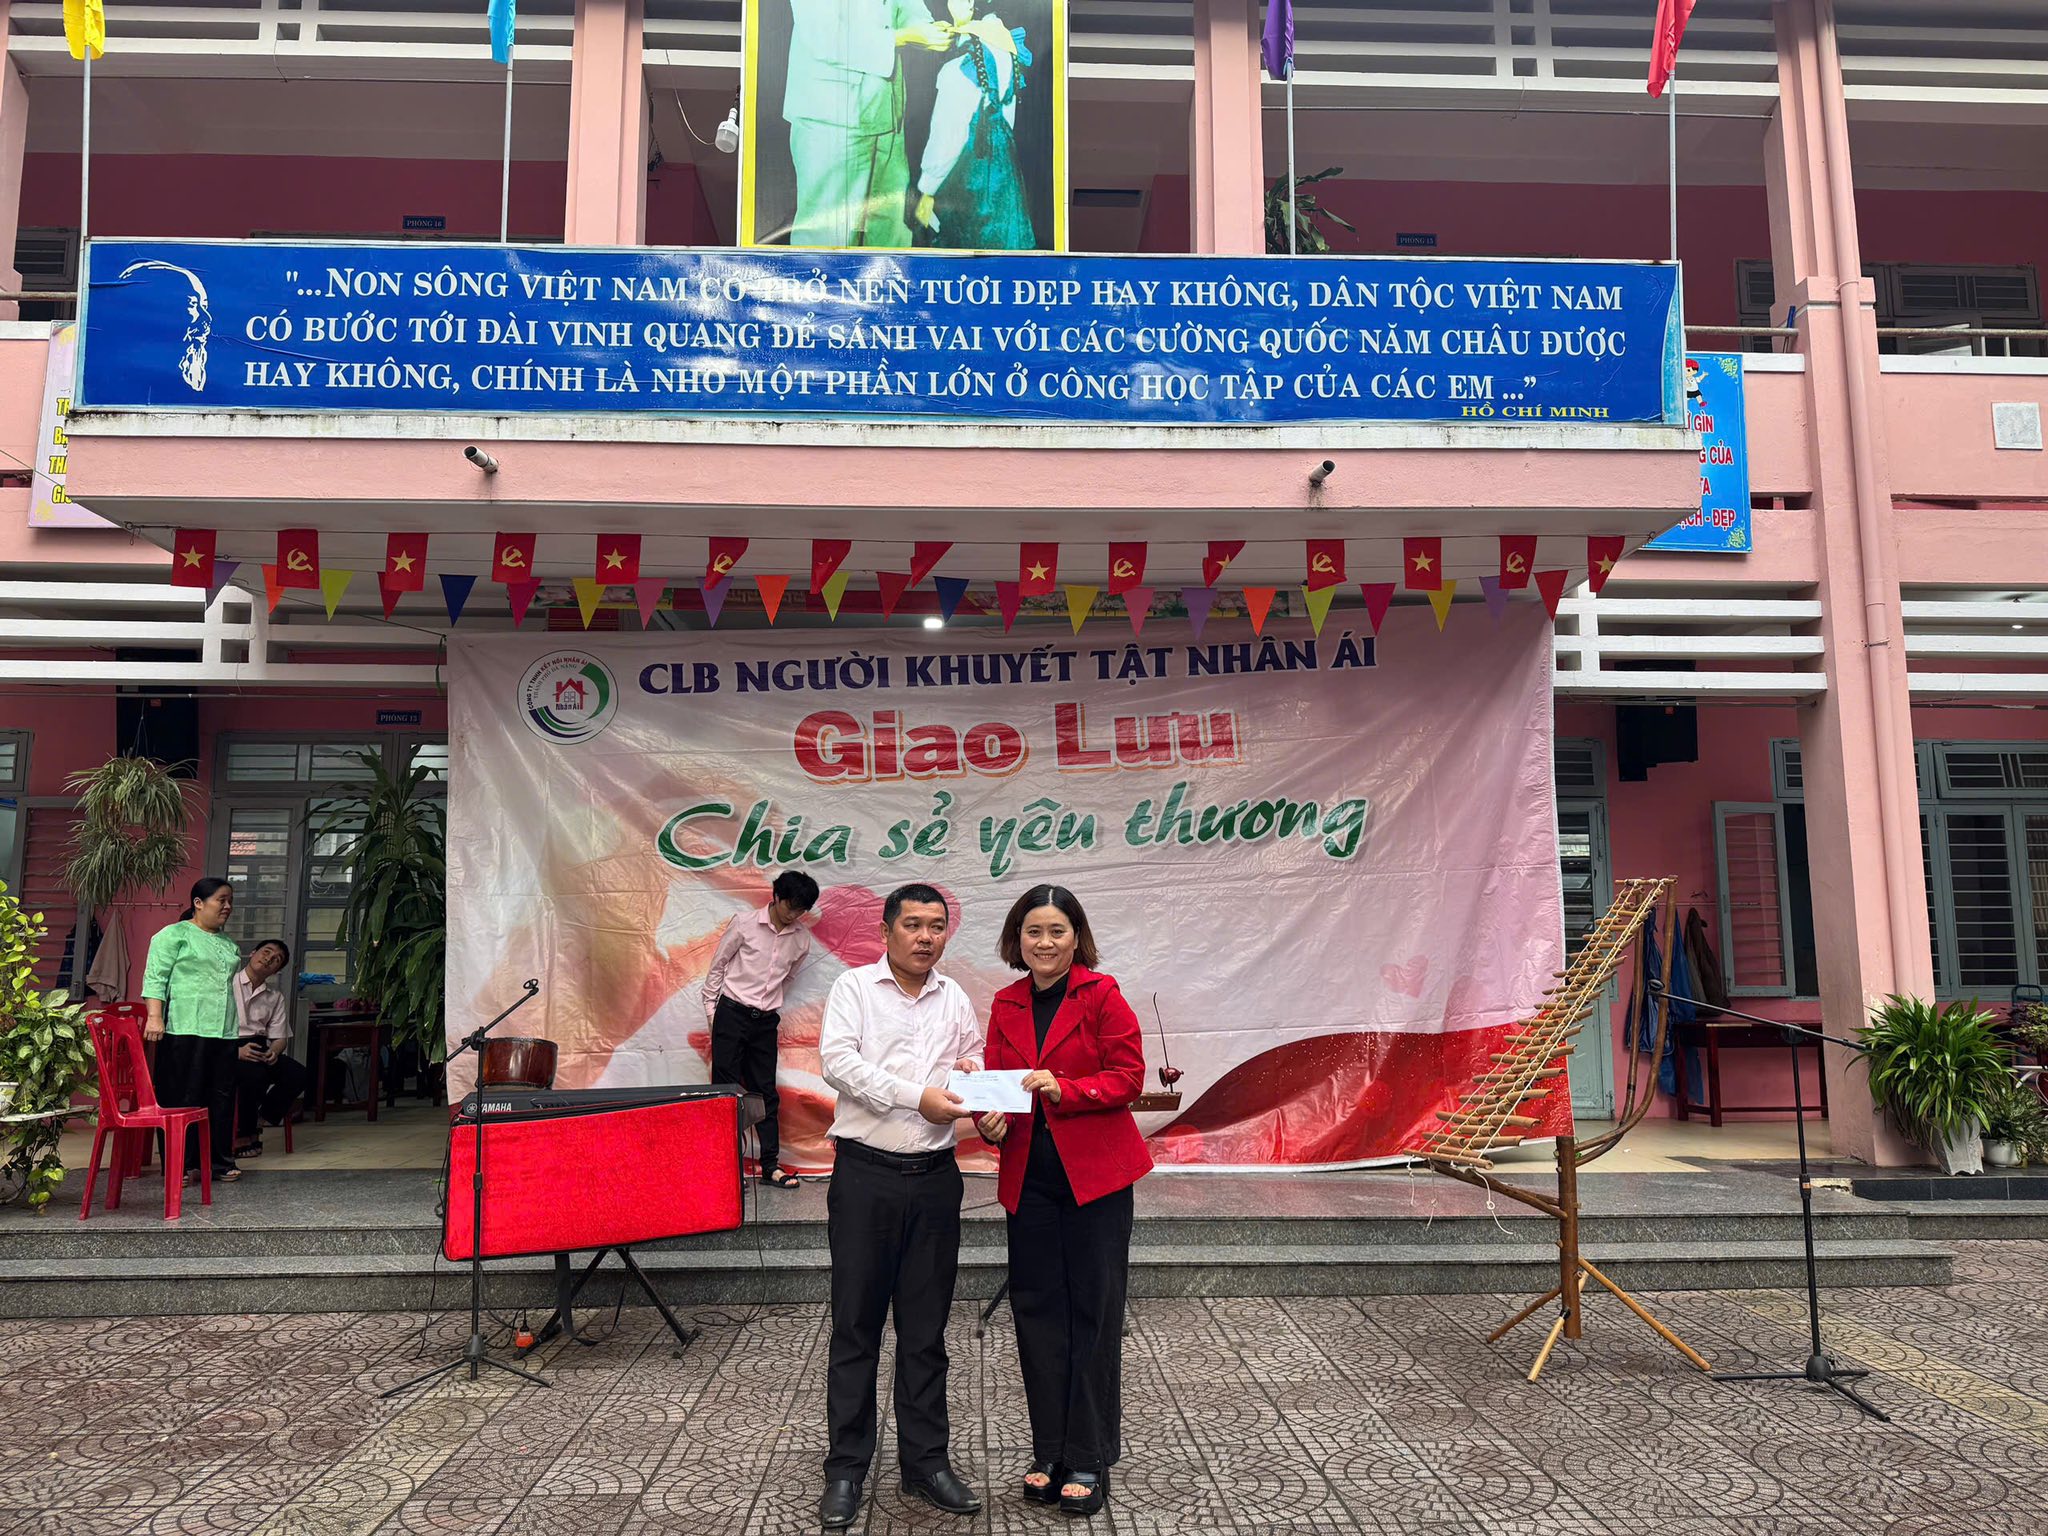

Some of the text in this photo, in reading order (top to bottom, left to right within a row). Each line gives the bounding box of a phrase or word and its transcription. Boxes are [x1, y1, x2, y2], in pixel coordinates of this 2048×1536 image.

[414, 265, 509, 298] SÔNG
[518, 269, 601, 307] VIỆT
[611, 277, 689, 301] NAM
[921, 274, 1002, 305] TƯƠI
[1013, 280, 1082, 311] ĐẸP
[1091, 281, 1160, 306] HAY
[1170, 274, 1299, 312] KHÔNG,
[1309, 275, 1379, 307] DÂN
[1389, 276, 1454, 315] TỘC
[1464, 277, 1542, 315] VIỆT
[1551, 286, 1623, 310] NAM
[245, 309, 1626, 362] CÓ BƯỚC TỚI ĐÀI VINH QUANG ĐỂ SÁNH VAI VỚI CÁC CƯỜNG QUỐC NĂM CHÂU ĐƯỢC
[243, 362, 317, 387] HAY
[325, 356, 460, 395] KHÔNG,
[471, 359, 585, 391] CHÍNH
[595, 360, 640, 393] LÀ
[737, 362, 815, 400] MỘT
[824, 357, 918, 396] PHẦN
[928, 364, 996, 396] LỚN
[1005, 362, 1029, 397] Ở
[1039, 367, 1130, 400] CÔNG
[1142, 374, 1210, 407] HỌC
[1220, 367, 1284, 407] TẬP
[1293, 363, 1361, 399] CỦA
[1371, 367, 1436, 400] CÁC
[1448, 375, 1494, 400] EM
[1461, 401, 1610, 418] HỒ CHÍ MINH
[1693, 410, 1714, 433] GÌN
[1709, 440, 1734, 465] CỦA
[1712, 508, 1736, 531] ĐẸP
[639, 631, 1377, 694] CLB NGƯỜI KHUYẾT TẬT NHÂN ÁI
[793, 702, 1244, 784] Giao Lưu
[656, 781, 1369, 878] Chia sẻ yêu thương
